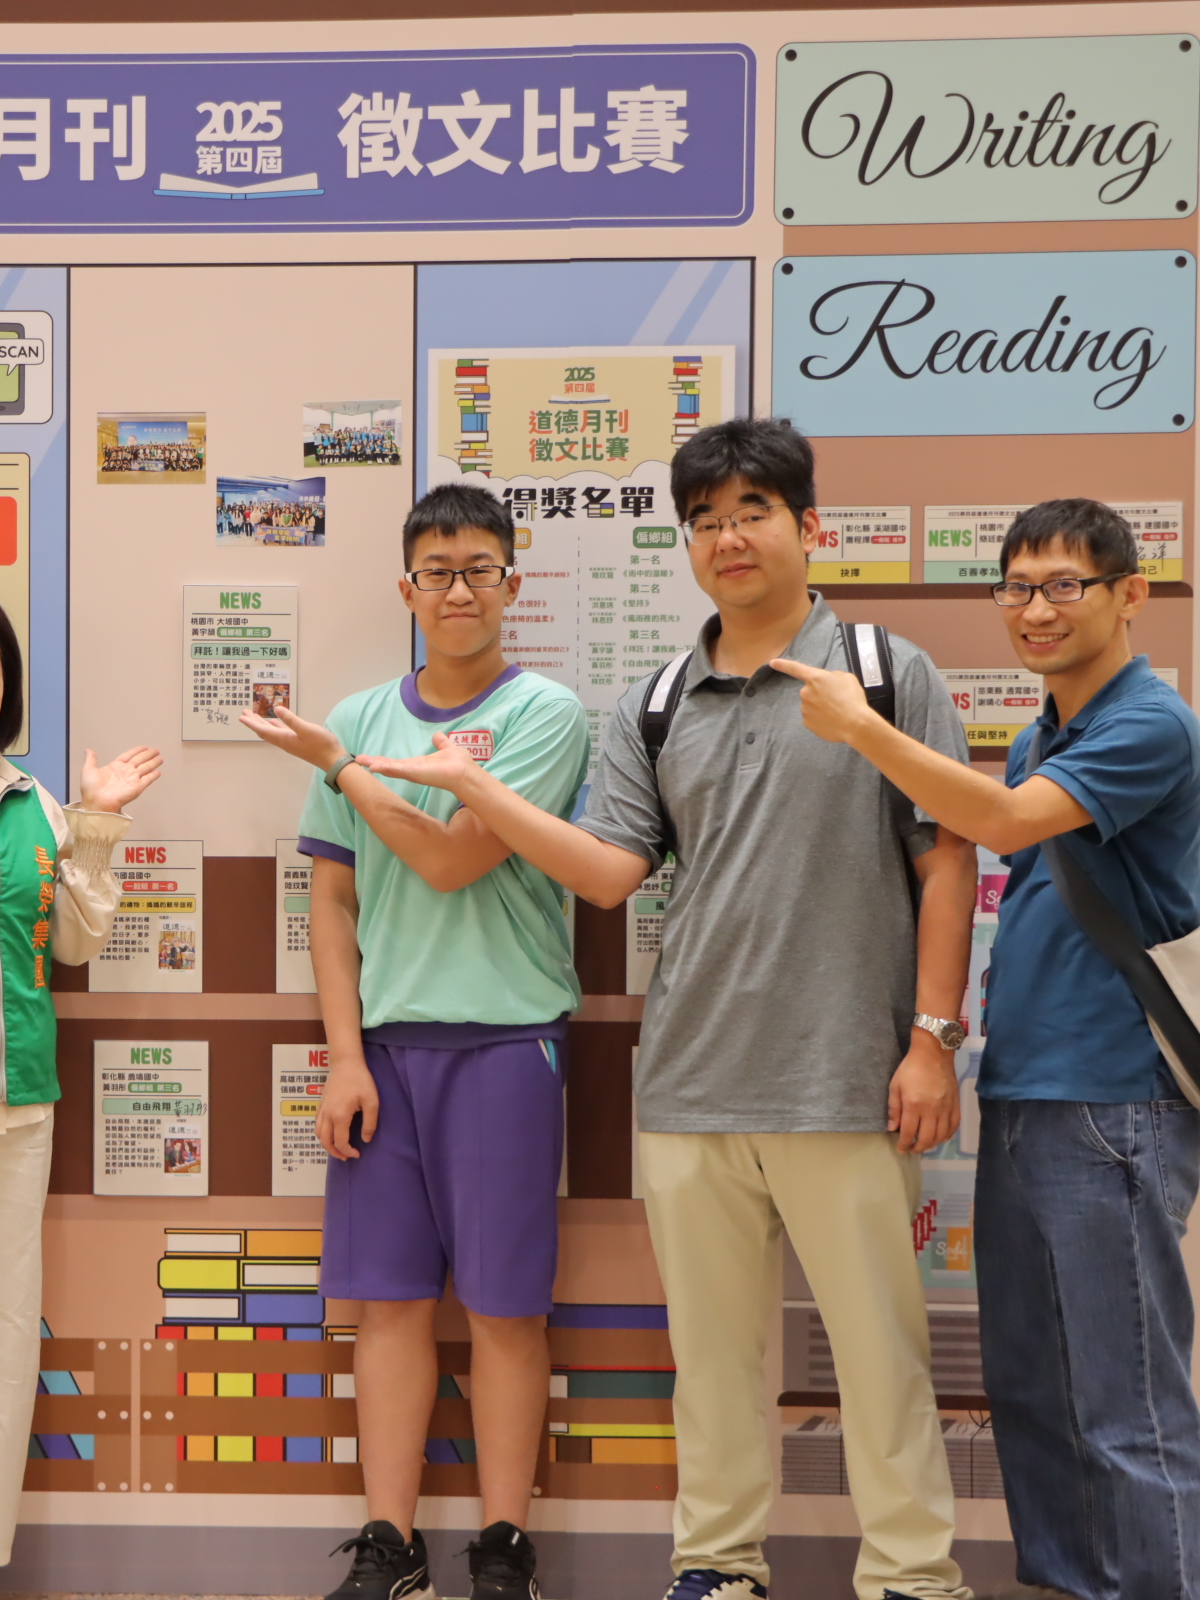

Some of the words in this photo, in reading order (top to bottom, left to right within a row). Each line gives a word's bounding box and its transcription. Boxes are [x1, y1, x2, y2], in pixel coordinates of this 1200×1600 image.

[195, 101, 284, 142] 2025
[337, 85, 690, 179] 徵文比賽
[801, 70, 1172, 204] Writing
[195, 145, 283, 175] 第四屆
[799, 278, 1167, 410] Reading
[564, 367, 595, 382] 2025
[564, 383, 595, 394] 第四屆
[528, 408, 629, 434] 道德月刊
[528, 437, 629, 462] 徵文比賽
[502, 486, 655, 521] 得獎名單
[636, 532, 673, 544] 偏鄉組
[928, 529, 972, 547] NEWS
[630, 555, 660, 565] 第一名
[840, 568, 860, 578] 抉擇
[630, 584, 660, 594] 第二名
[220, 592, 262, 609] NEWS
[191, 617, 214, 626] 桃園市
[629, 630, 660, 640] 第三名
[622, 645, 696, 653] 《拜託！讓我過一下
[125, 847, 167, 864] NEWS
[131, 1047, 172, 1064] NEWS
[133, 1102, 171, 1111] 自由飛翔
